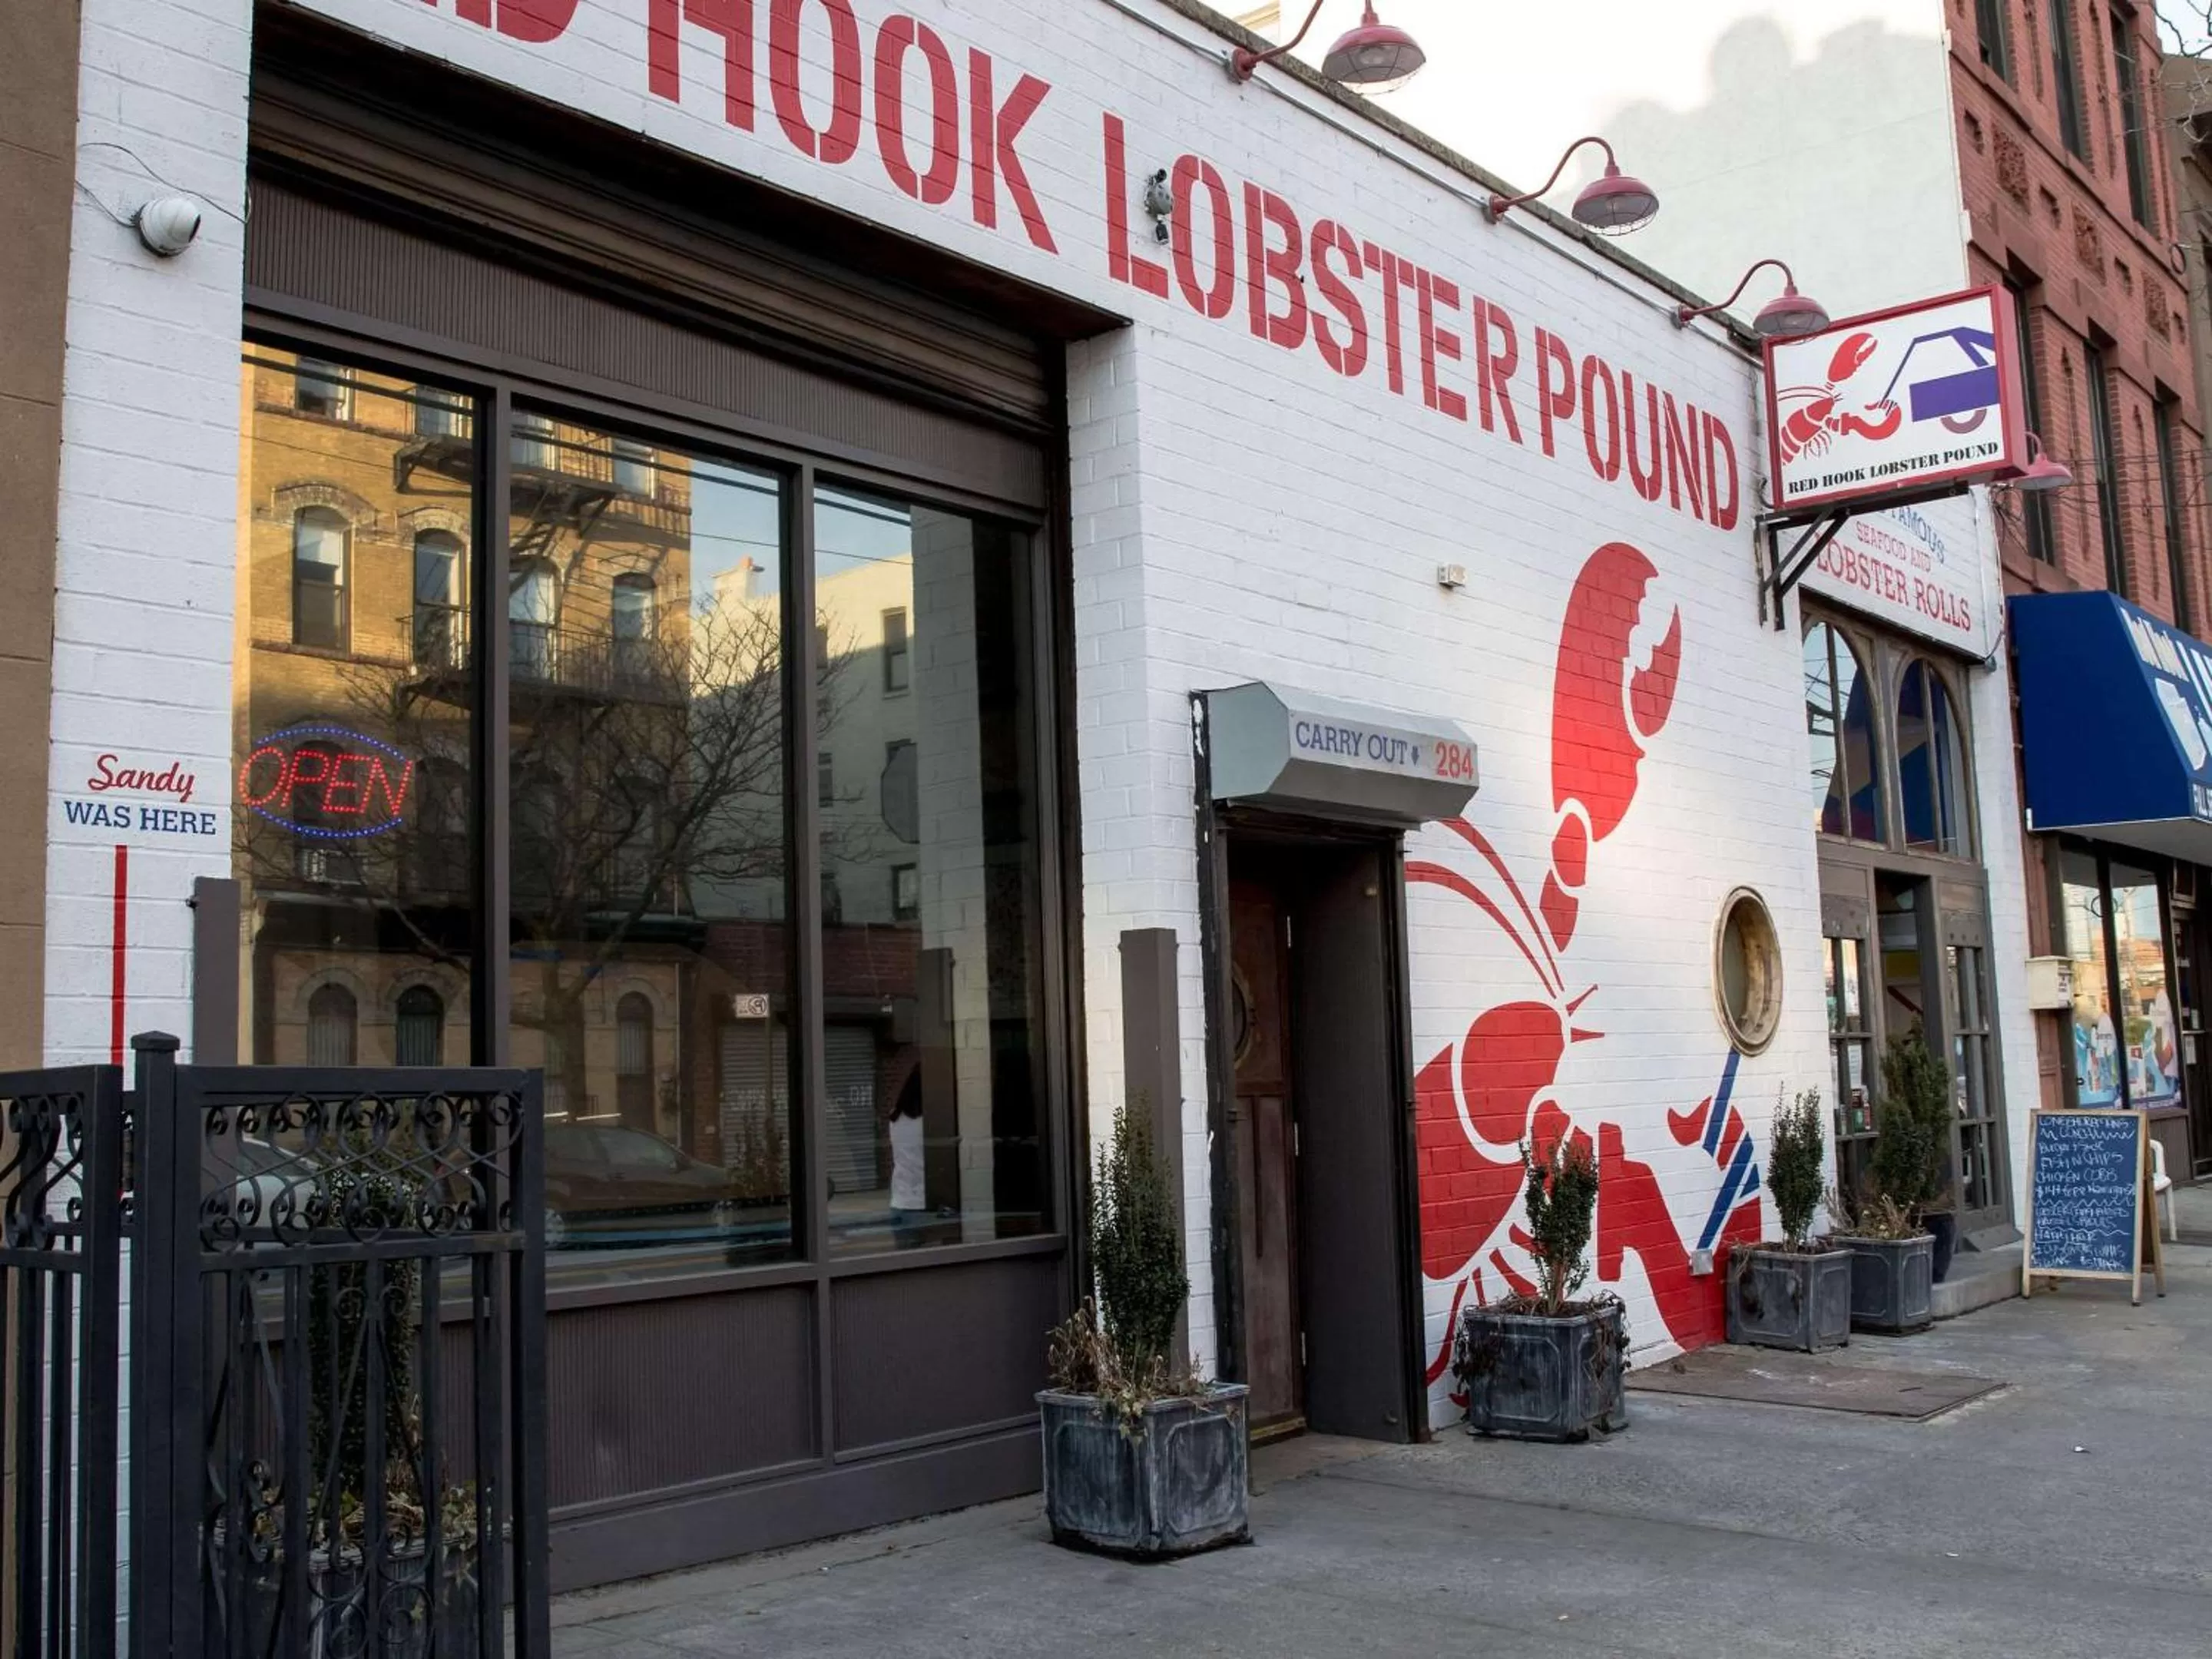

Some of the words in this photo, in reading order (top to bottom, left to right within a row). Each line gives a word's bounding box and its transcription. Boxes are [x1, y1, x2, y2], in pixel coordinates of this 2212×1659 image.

[648, 0, 1058, 255] HOOK
[1102, 111, 1523, 445] LOBSTER
[1535, 325, 1739, 531] POUND
[1788, 478, 1819, 494] RED
[1823, 469, 1866, 488] HOOK
[1870, 453, 1940, 478] LOBSTER
[1943, 442, 1998, 464] POUND
[1856, 521, 1907, 561] SEAFOOD
[1910, 547, 1932, 572] AND
[1912, 577, 1972, 633] ROLLS
[1296, 720, 1363, 757] CARRY
[1368, 734, 1408, 765] OUT
[1435, 741, 1474, 780] 284
[88, 754, 195, 802] Sandy
[239, 745, 412, 816] OPEN
[64, 801, 131, 829] WAS
[140, 810, 217, 836] HERE
